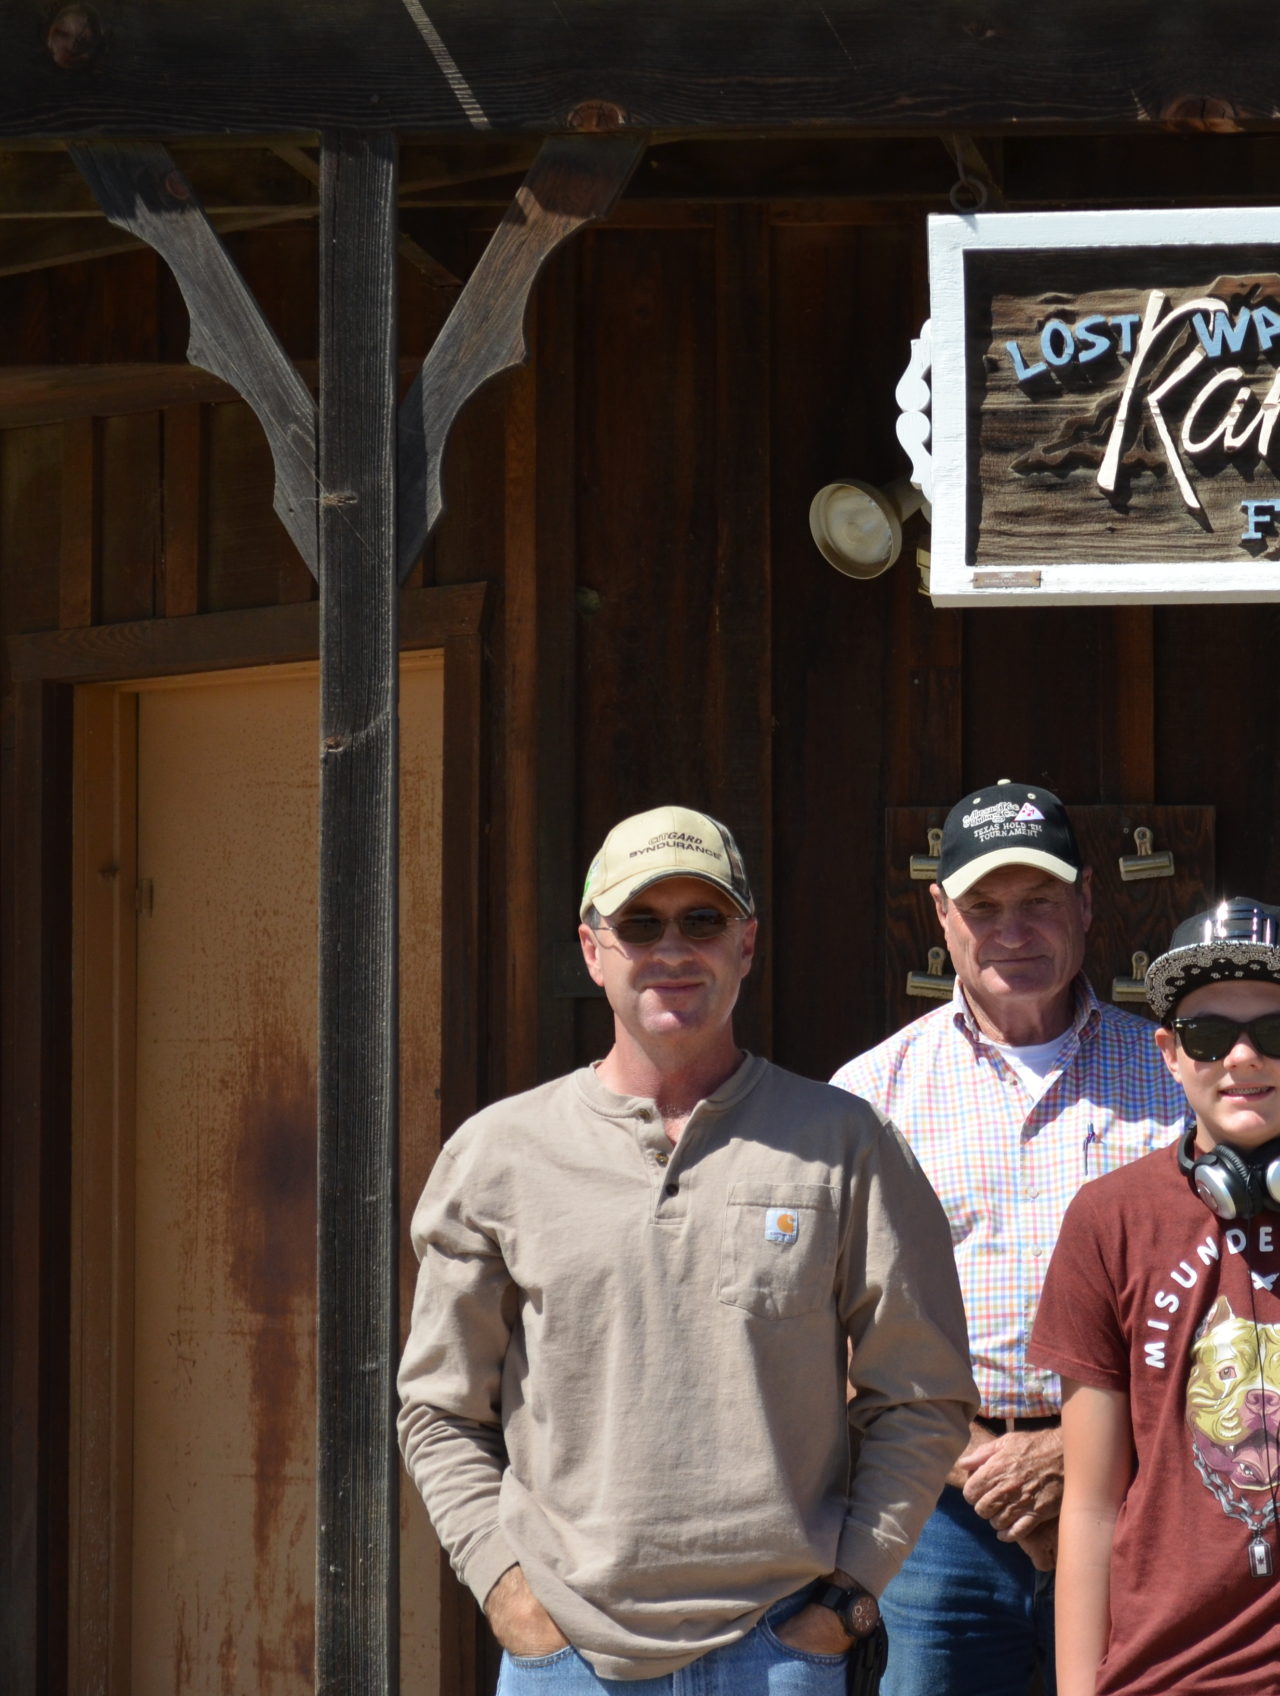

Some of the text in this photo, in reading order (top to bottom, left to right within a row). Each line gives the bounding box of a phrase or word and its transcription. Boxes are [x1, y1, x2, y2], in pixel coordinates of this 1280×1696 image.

[1005, 313, 1141, 382] LOST
[974, 824, 1000, 837] TEXAS
[1003, 822, 1027, 830] HOLD
[979, 828, 1038, 842] TOURNAMENT
[629, 841, 722, 860] SYNDURANCE
